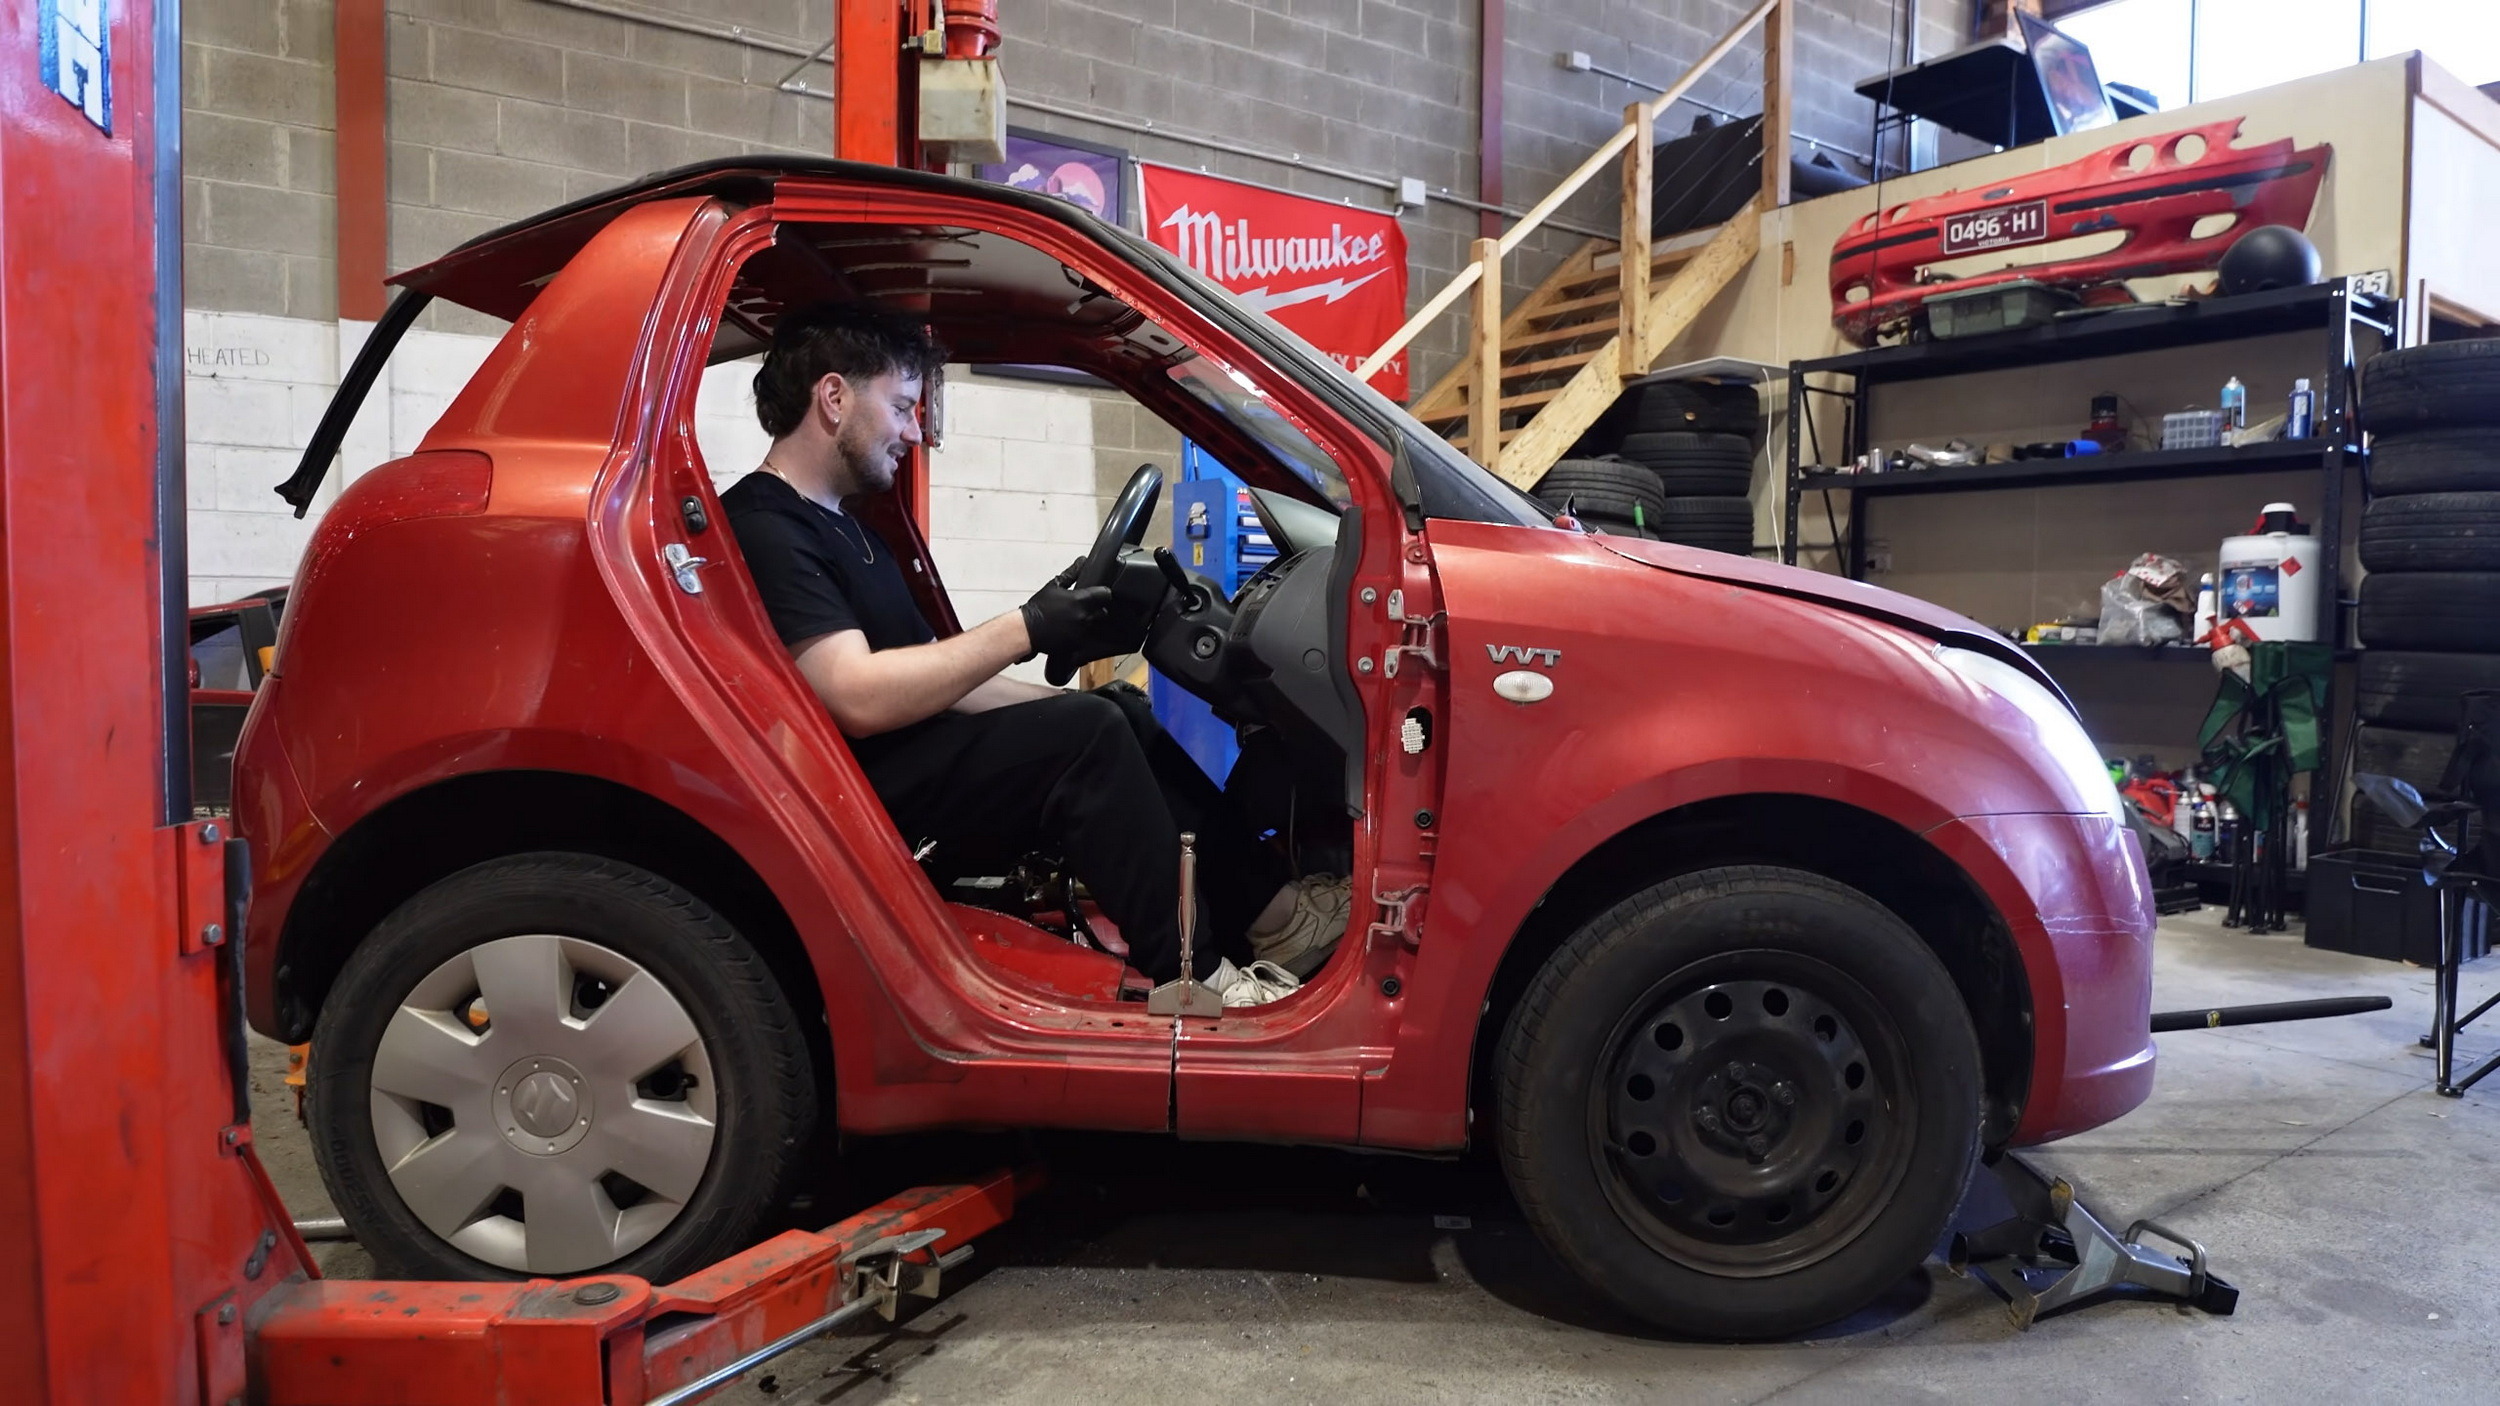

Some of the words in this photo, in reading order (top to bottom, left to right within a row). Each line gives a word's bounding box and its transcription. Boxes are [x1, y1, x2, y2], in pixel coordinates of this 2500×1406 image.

[1160, 203, 1386, 282] Milwaukee
[187, 347, 270, 366] HEATED
[1486, 644, 1561, 667] VVT
